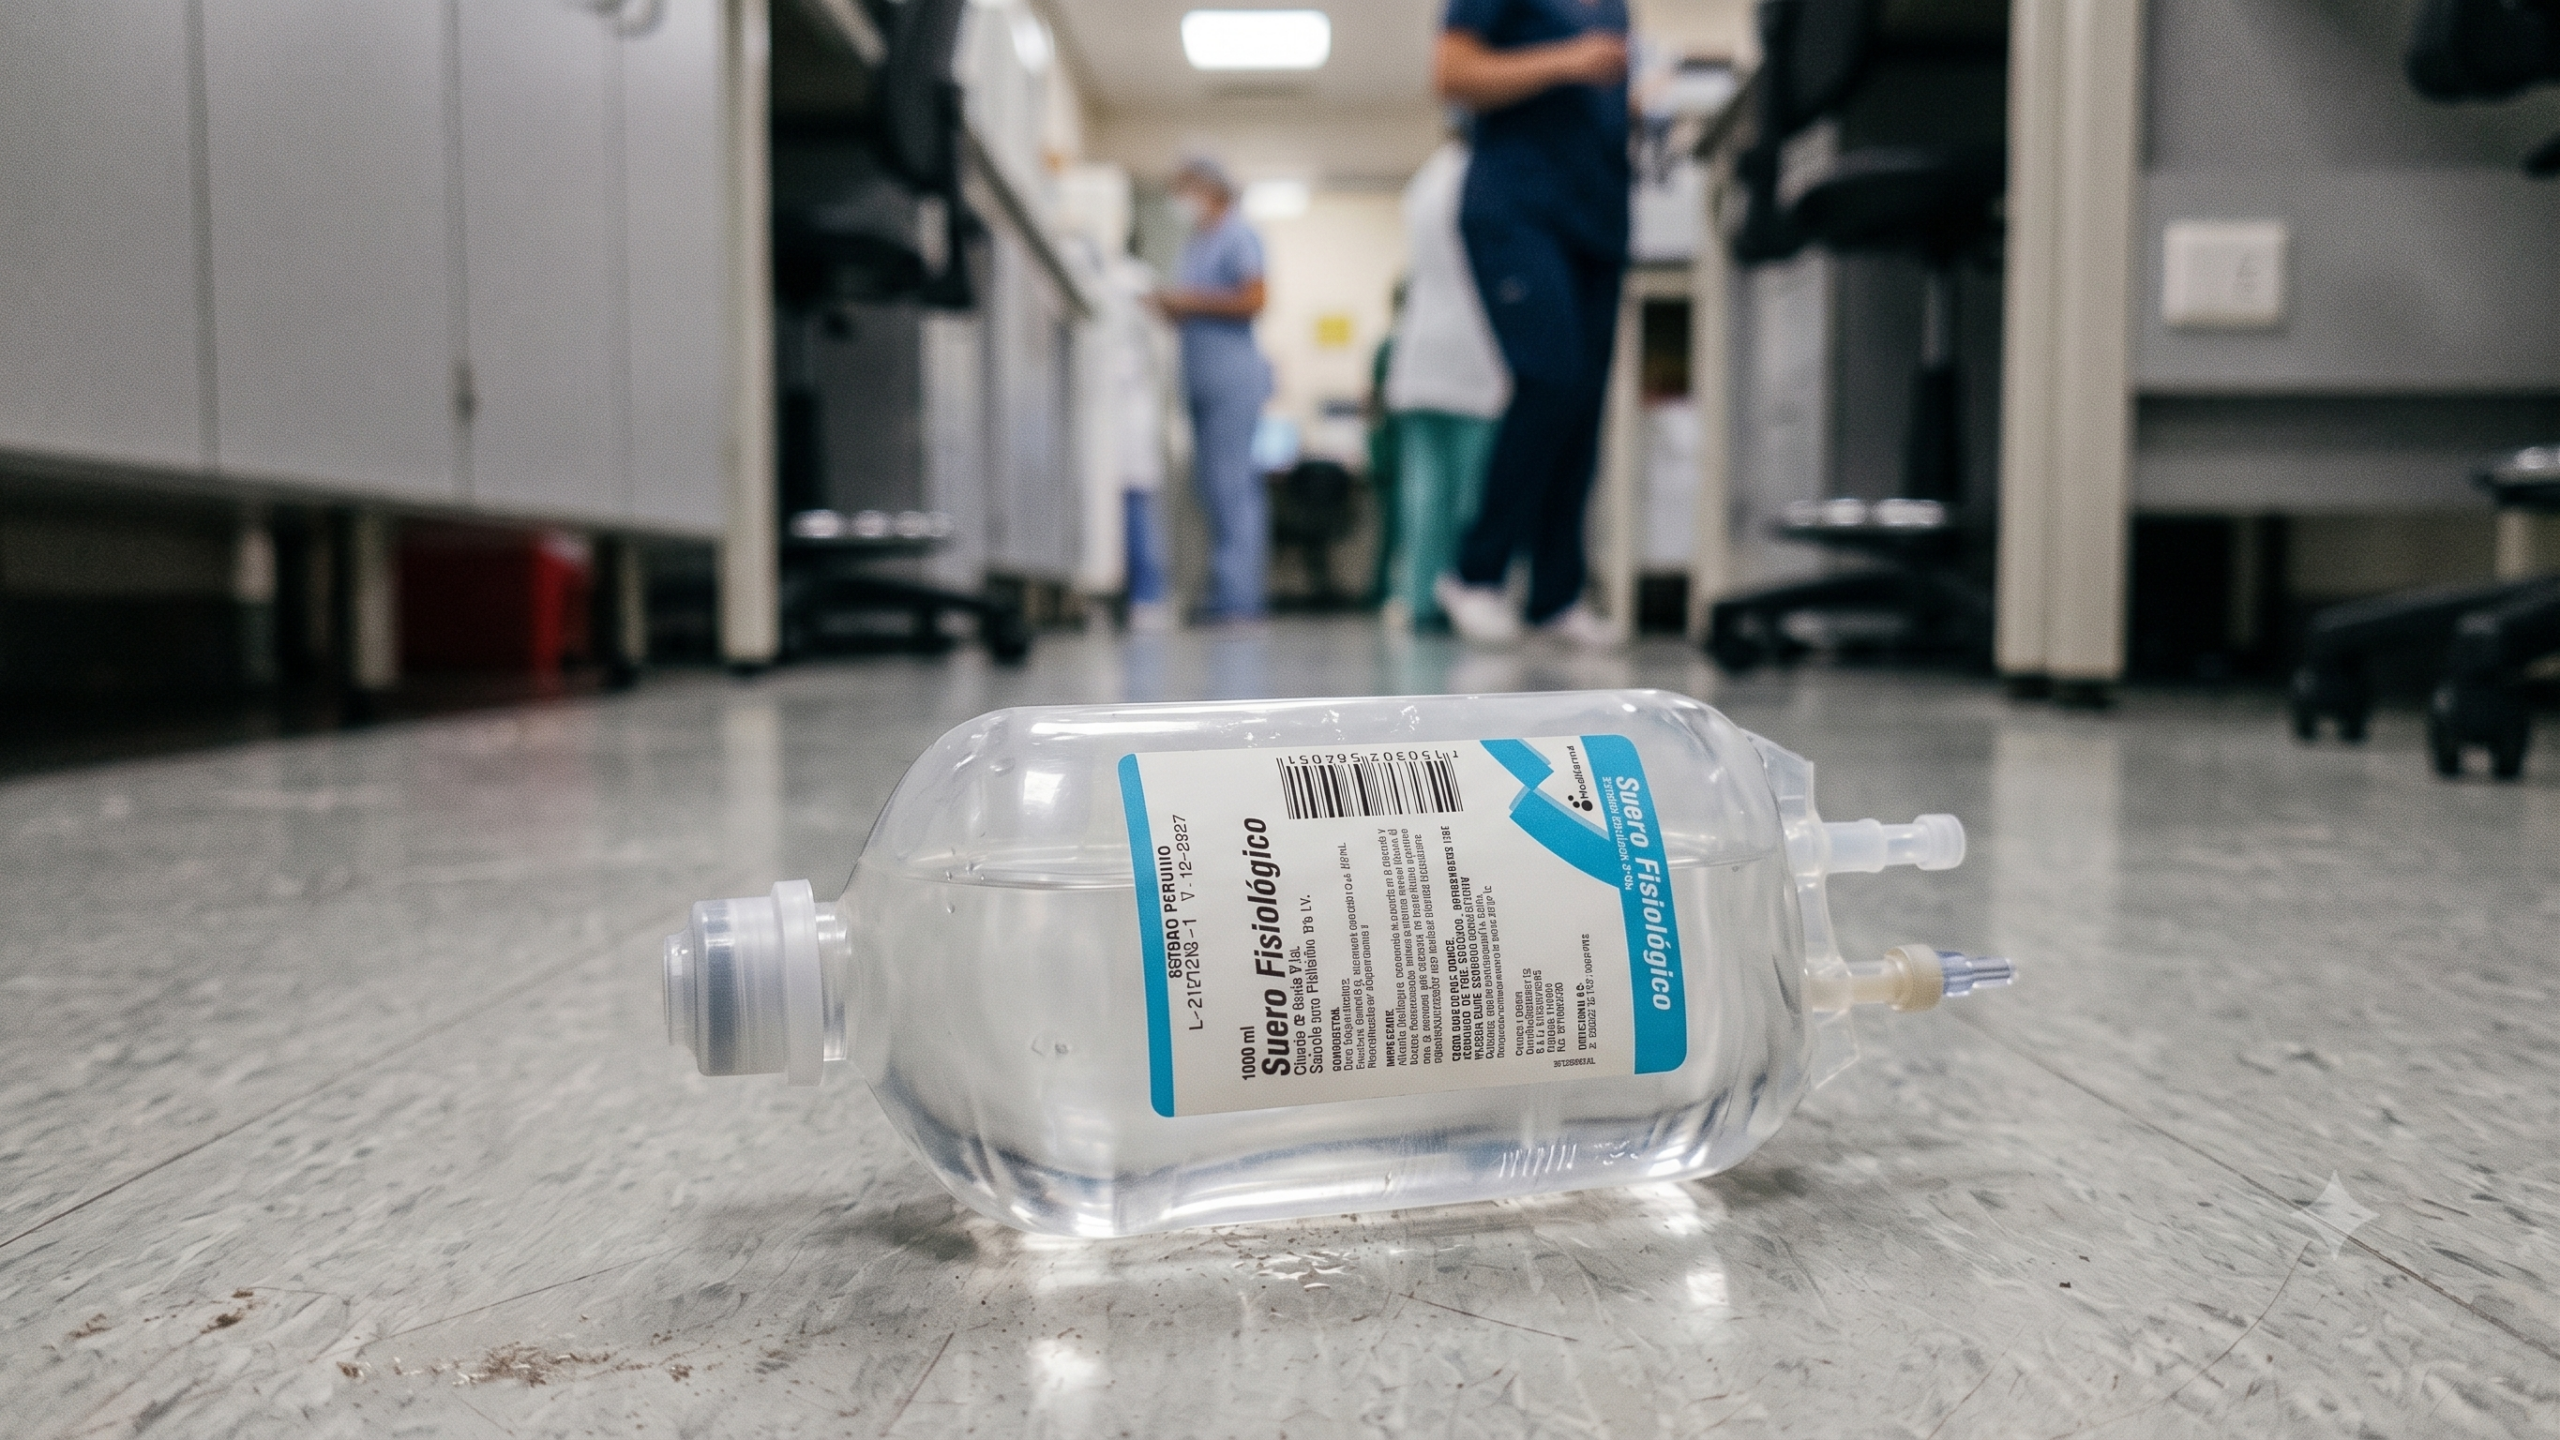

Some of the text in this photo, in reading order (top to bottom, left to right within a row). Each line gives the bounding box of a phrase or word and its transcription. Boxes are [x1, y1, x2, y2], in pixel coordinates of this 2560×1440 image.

[1242, 817, 1291, 1076] Suero Fisiológico
[1615, 776, 1650, 848] Suero
[1635, 857, 1672, 1011] Fisiológico
[1239, 1025, 1256, 1080] 1000 ml
